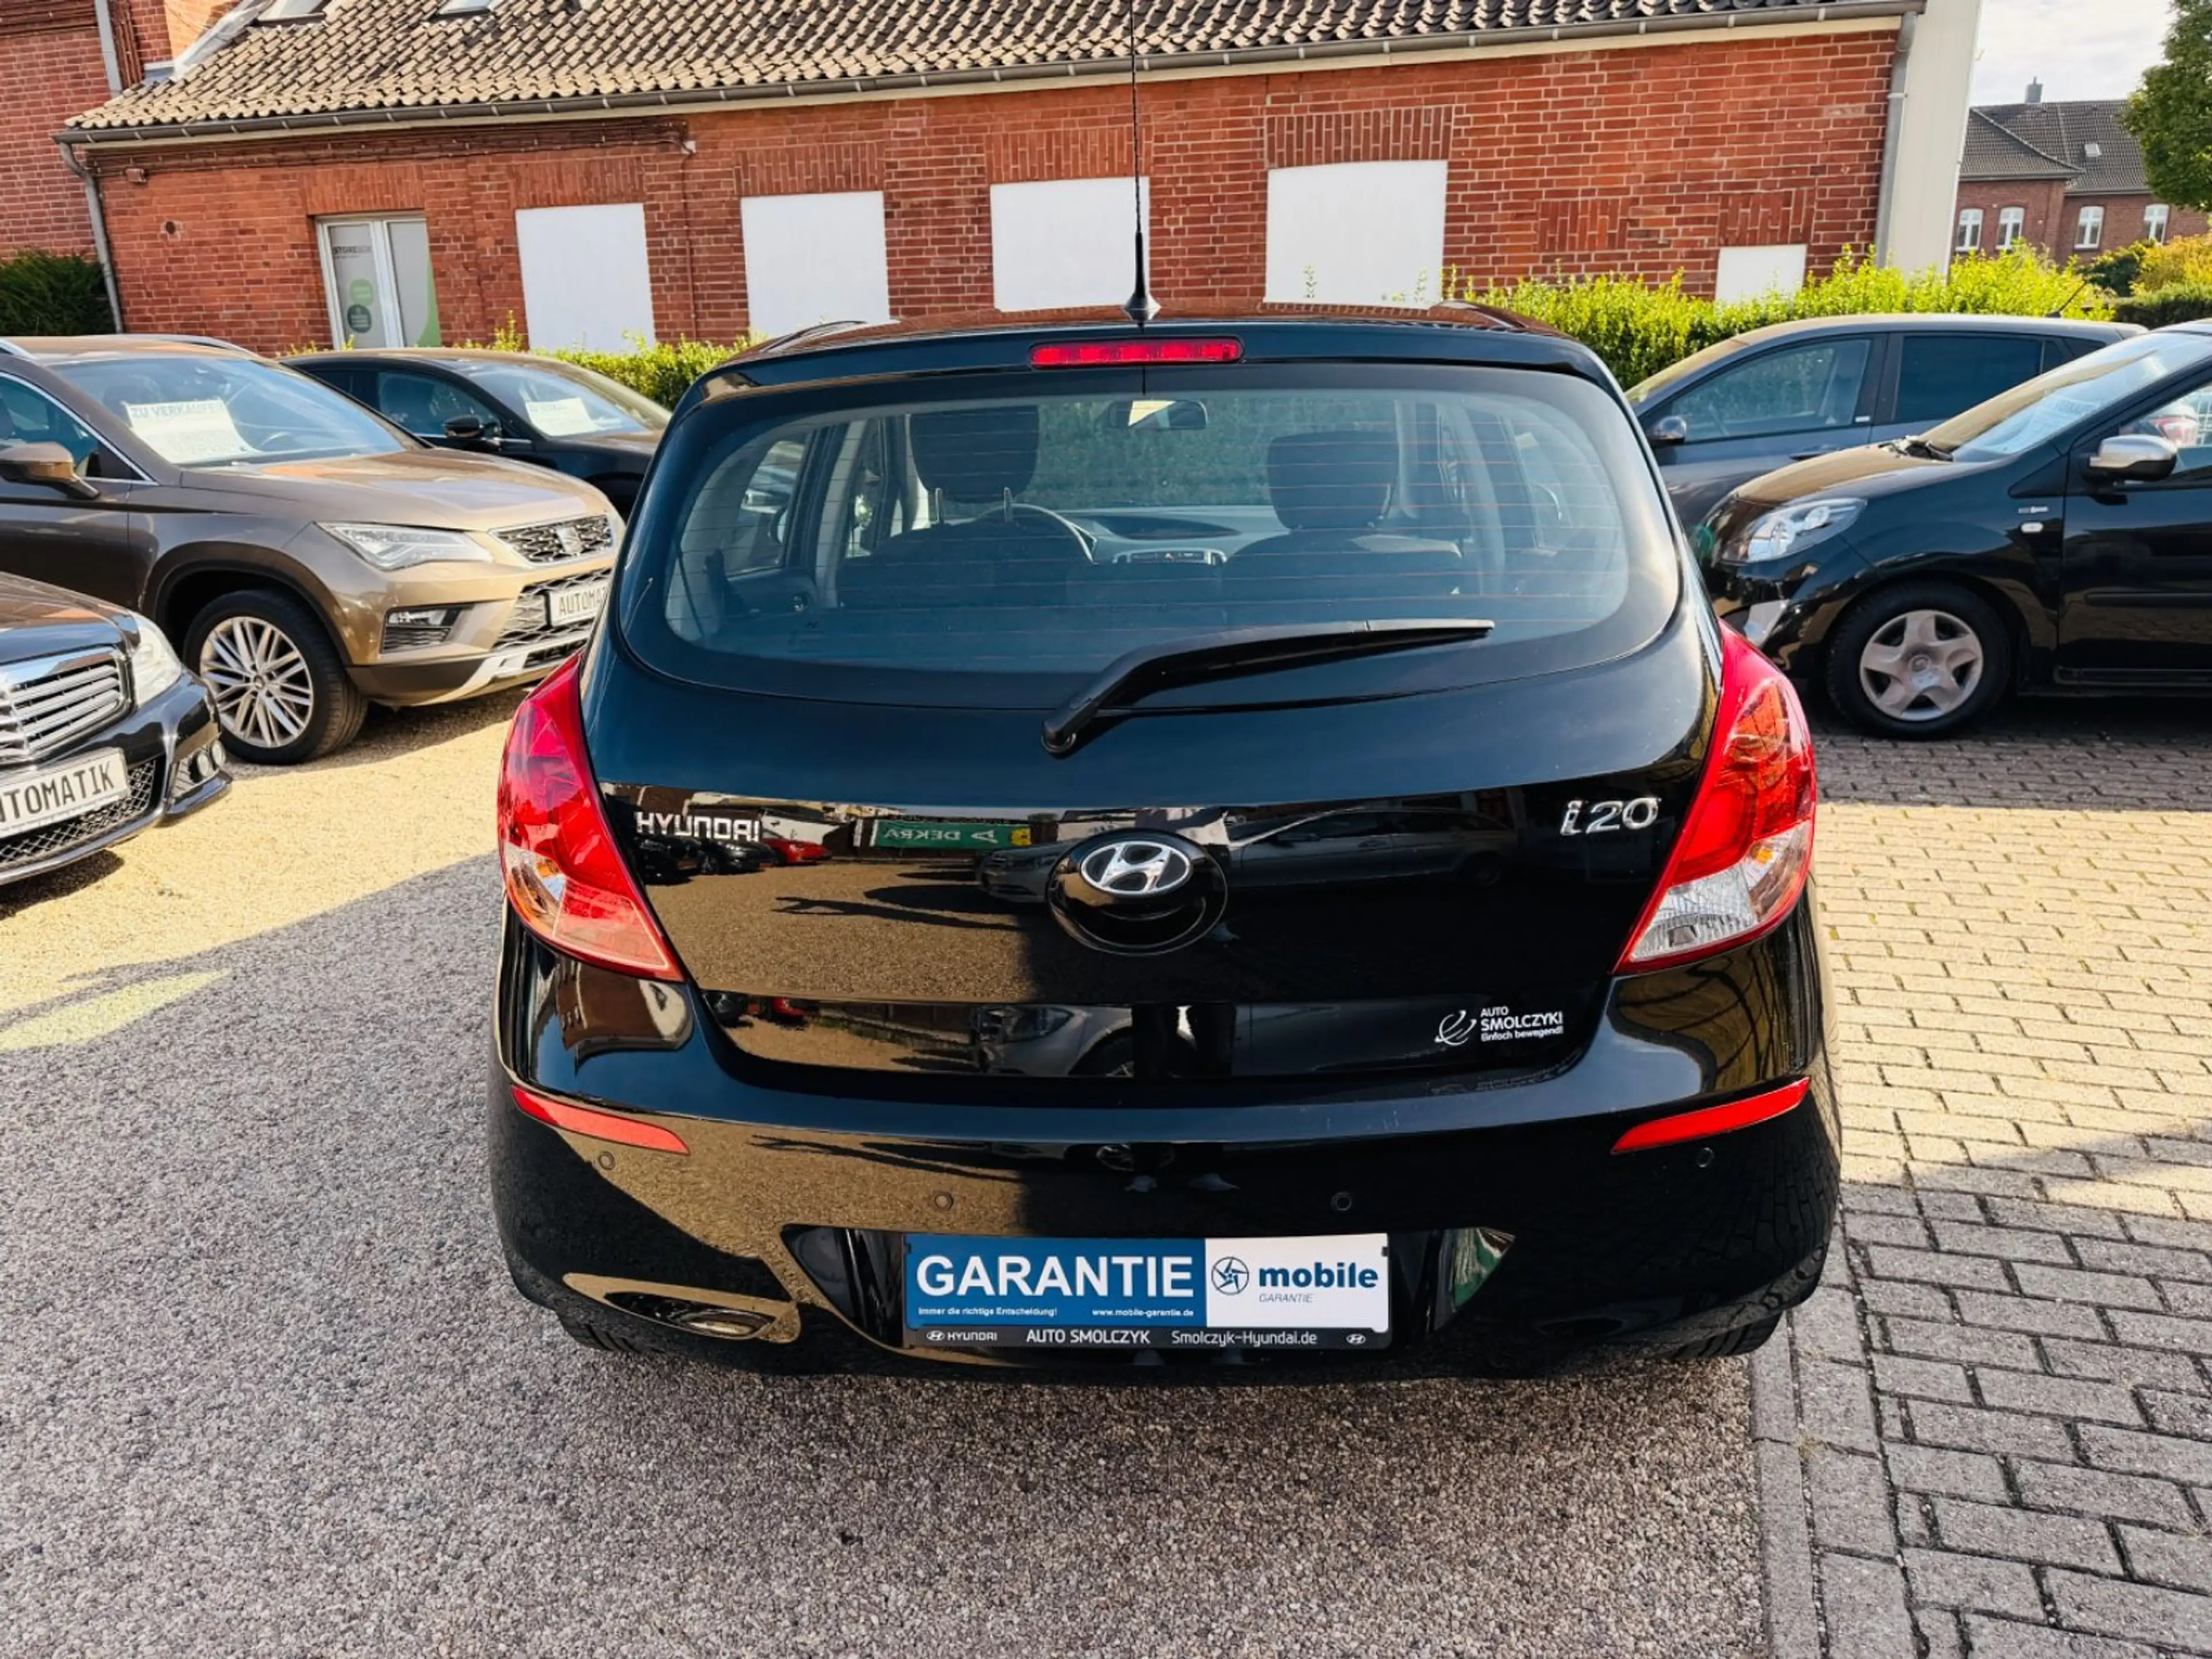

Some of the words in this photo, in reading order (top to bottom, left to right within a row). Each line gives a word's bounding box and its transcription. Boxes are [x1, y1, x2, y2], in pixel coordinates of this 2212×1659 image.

[1560, 797, 1660, 836] i20
[636, 811, 760, 842] HYUNDAI
[1480, 1006, 1509, 1017] AUTO
[916, 1255, 1194, 1297] GARANTIE
[1259, 1262, 1378, 1288] mobile
[1259, 1293, 1313, 1303] GARANTIE
[918, 1307, 945, 1315] Immer
[947, 1307, 960, 1315] die
[962, 1307, 994, 1317] richtige
[996, 1307, 1058, 1317] Entscheidung!
[1092, 1309, 1195, 1319] www.mobile-garantie.de
[947, 1332, 998, 1341] HYUNDAI
[1025, 1329, 1066, 1343] AUTO
[1070, 1329, 1151, 1344] SMOLCZYK
[1171, 1330, 1318, 1347] Smolczyk-Hyundai.de
